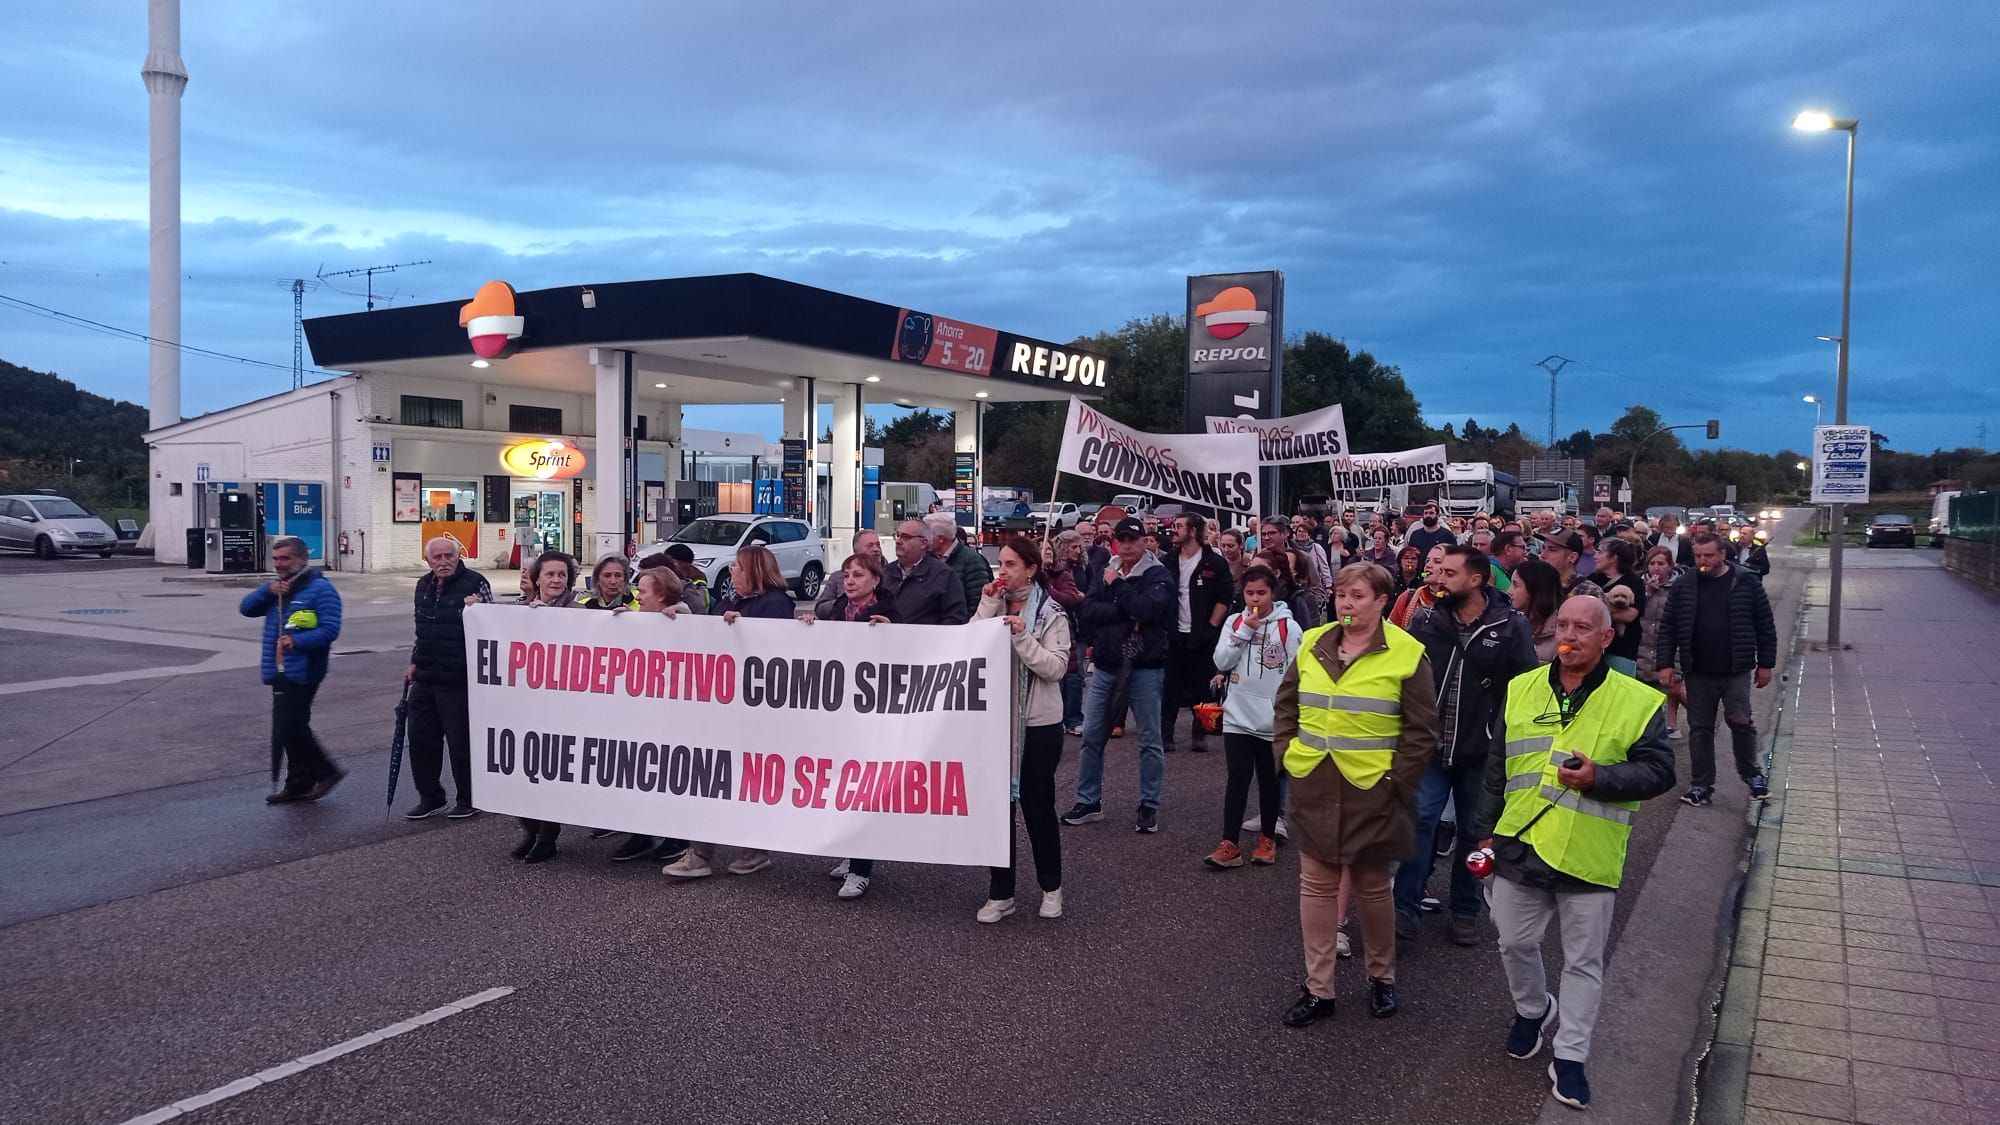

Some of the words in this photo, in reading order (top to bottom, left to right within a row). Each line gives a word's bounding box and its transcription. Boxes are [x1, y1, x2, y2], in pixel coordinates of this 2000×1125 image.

[936, 321, 964, 340] Ahorra
[941, 341, 953, 365] 5
[965, 346, 985, 371] 20
[1011, 342, 1106, 388] REPSOL
[1194, 347, 1267, 362] REPSOL
[529, 451, 573, 470] Sprint
[1078, 436, 1253, 512] CONDICIONES
[1334, 462, 1446, 490] TRABAJADORES
[477, 638, 502, 686] EL
[507, 641, 736, 705] POLIDEPORTIVO
[742, 655, 845, 712] COMO
[853, 657, 987, 715] SIEMPRE
[487, 727, 516, 776] LO
[523, 731, 577, 784] QUE
[581, 736, 733, 801] FUNCIONA
[738, 751, 786, 806] NO
[791, 755, 833, 809] SE
[835, 759, 969, 817] CAMBIA
